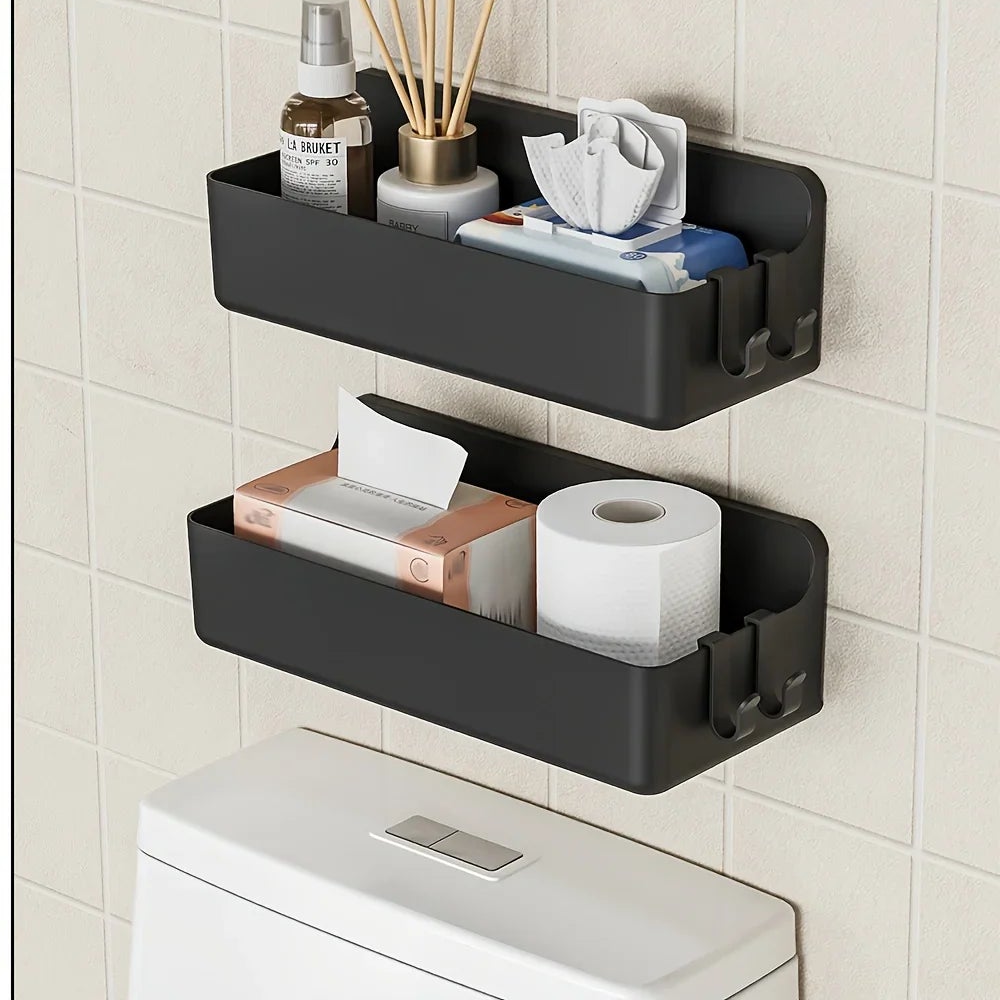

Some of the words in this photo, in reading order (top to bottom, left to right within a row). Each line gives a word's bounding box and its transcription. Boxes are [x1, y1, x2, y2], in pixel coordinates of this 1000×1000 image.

[301, 140, 341, 154] BRUKET
[306, 158, 320, 167] SPF
[326, 158, 339, 167] 30
